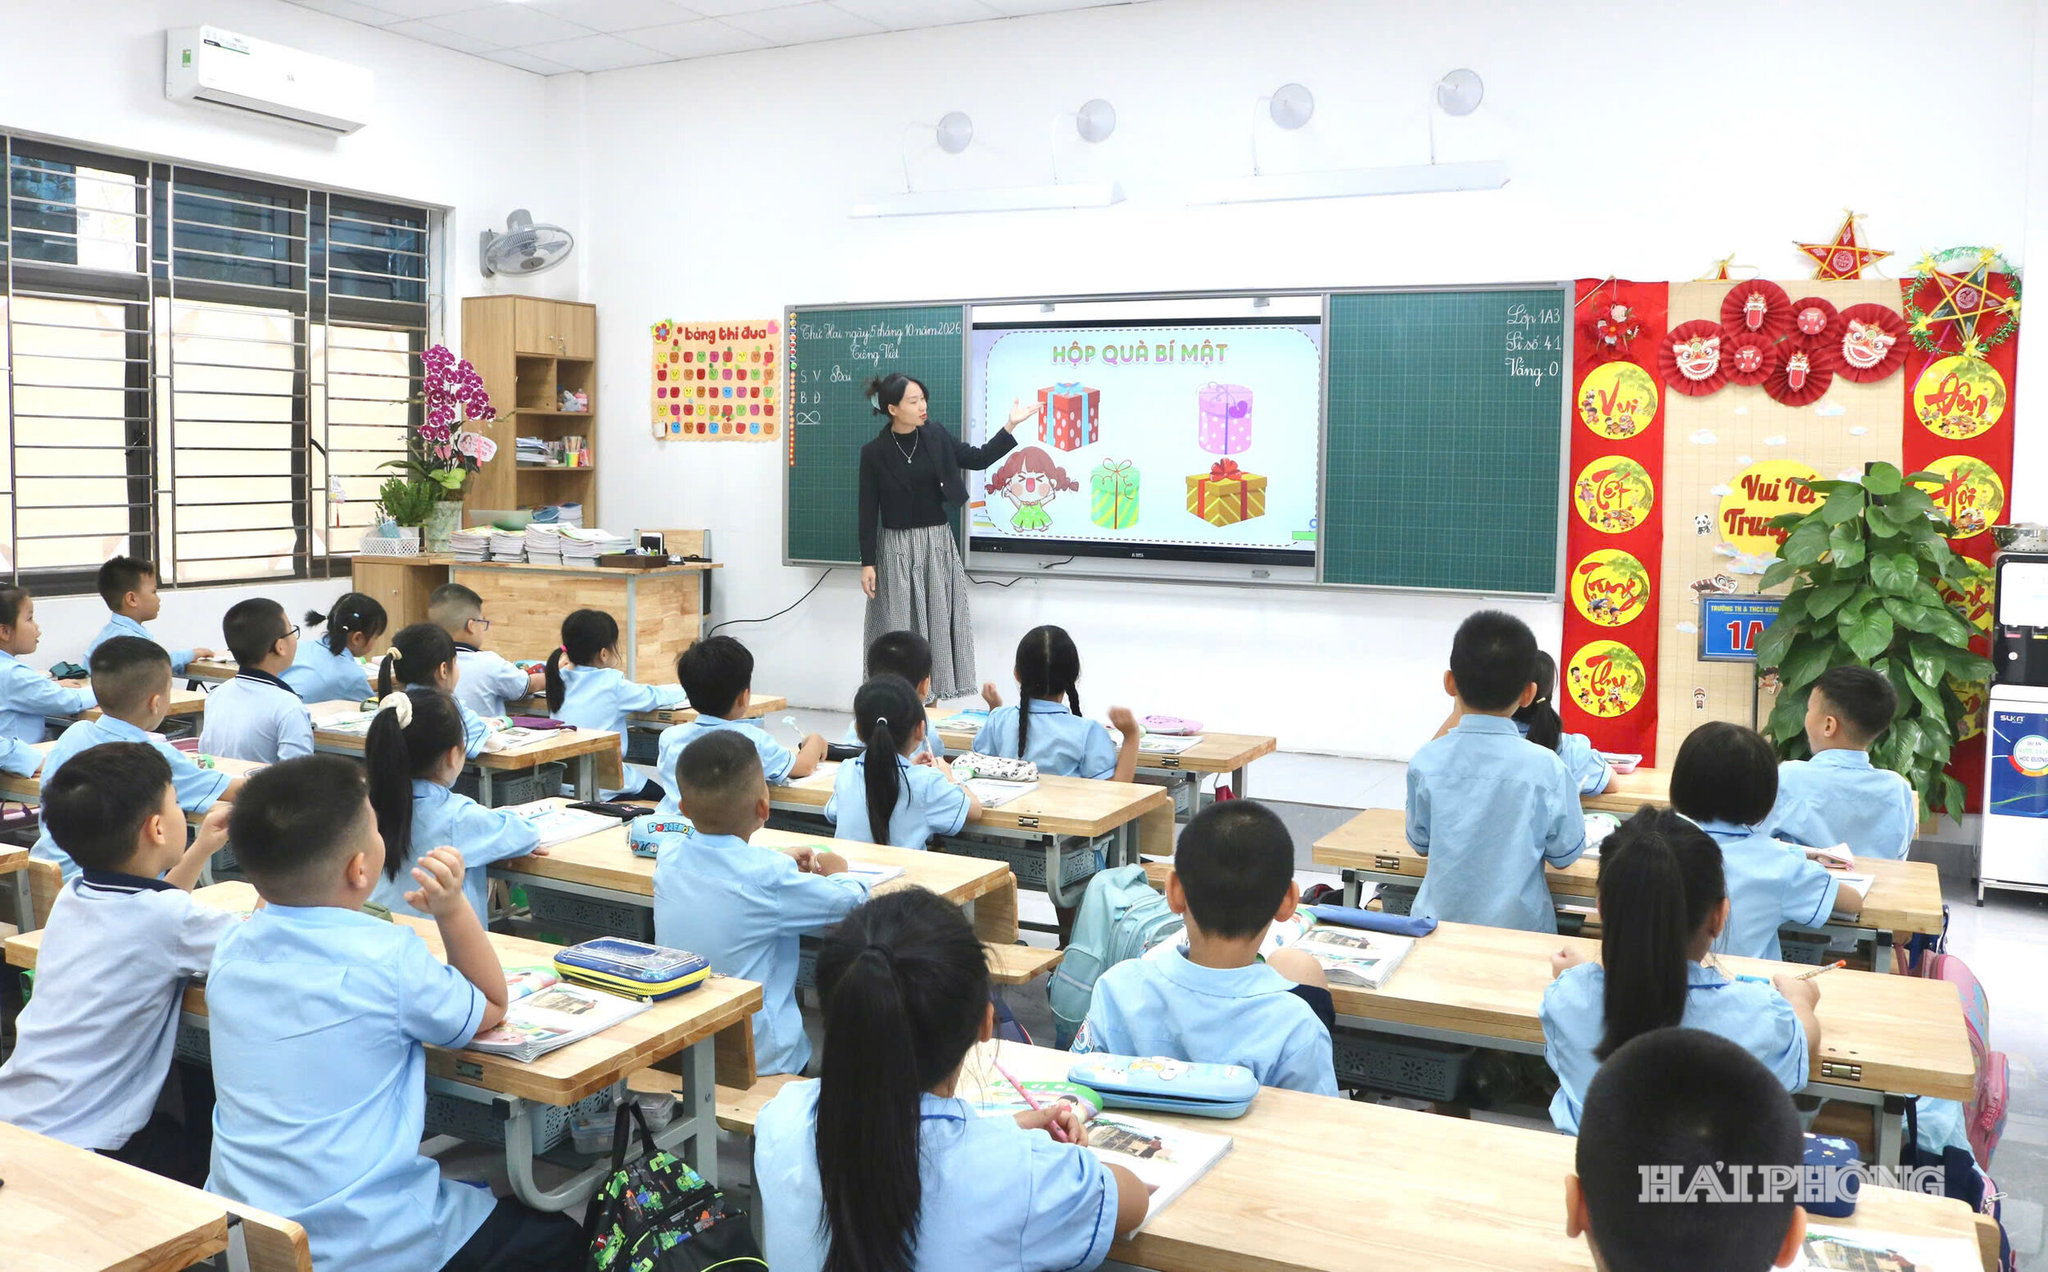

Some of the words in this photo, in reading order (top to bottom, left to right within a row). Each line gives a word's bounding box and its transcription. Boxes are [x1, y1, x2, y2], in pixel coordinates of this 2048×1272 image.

[1506, 304, 1536, 330] Lớp
[1538, 308, 1560, 324] 1A3
[685, 327, 716, 344] bảng
[719, 326, 739, 340] thi
[741, 326, 766, 339] đua
[824, 323, 842, 339] Hai
[845, 327, 869, 346] ngày
[870, 324, 877, 337] 5
[877, 321, 903, 346] tháng
[905, 323, 915, 336] 10
[915, 325, 937, 336] năm
[1544, 335, 1561, 350] 41
[850, 344, 880, 367] Tiếng
[879, 343, 899, 361] Việt
[1053, 340, 1096, 367] HỘP
[1102, 340, 1149, 365] QUÀ
[1156, 339, 1175, 363] BÍ
[1181, 339, 1229, 367] MẬT
[1549, 361, 1559, 376] 0
[1598, 377, 1639, 417] Vui
[1591, 469, 1631, 510] Tết
[1741, 474, 1781, 501] Vui
[1727, 620, 1765, 651] 1A
[1586, 655, 1626, 697] Thu
